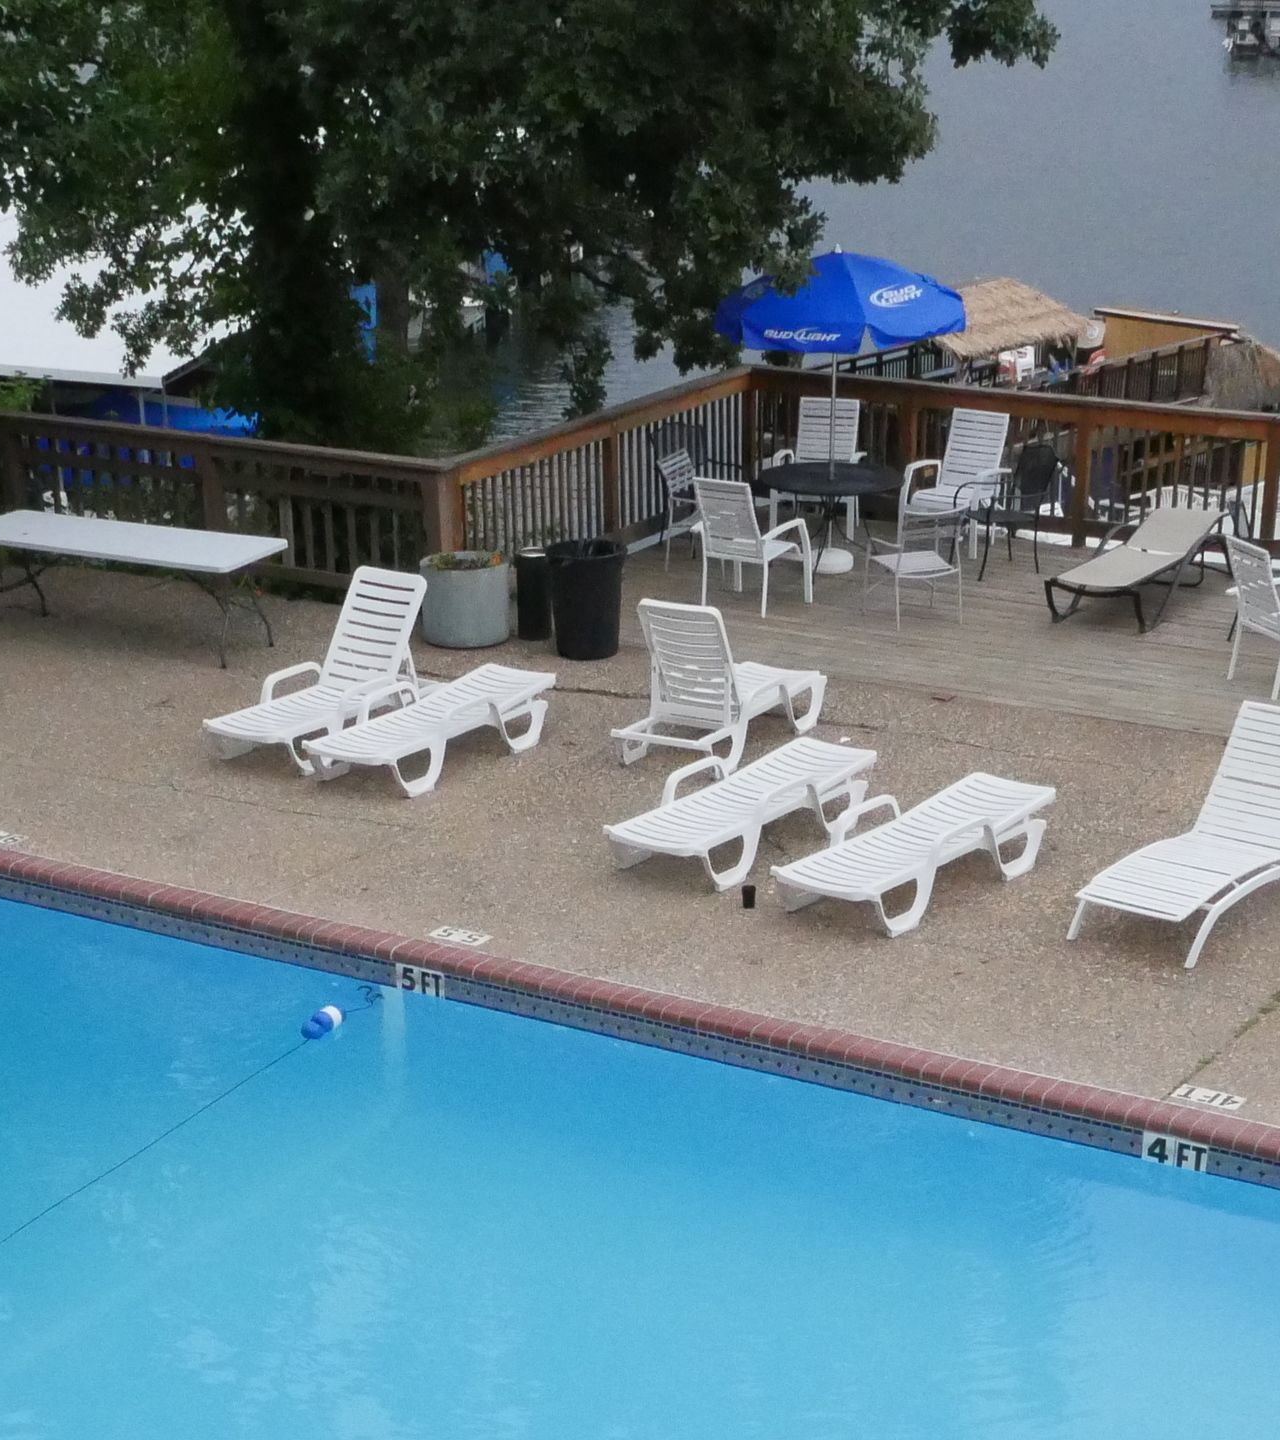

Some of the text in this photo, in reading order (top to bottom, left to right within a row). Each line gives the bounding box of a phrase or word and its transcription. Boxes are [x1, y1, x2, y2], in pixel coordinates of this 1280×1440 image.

[763, 329, 842, 342] BUD LIGHT
[401, 966, 442, 998] 5 FT
[1176, 1087, 1240, 1106] 4FT
[1147, 1137, 1208, 1172] 4 FT
